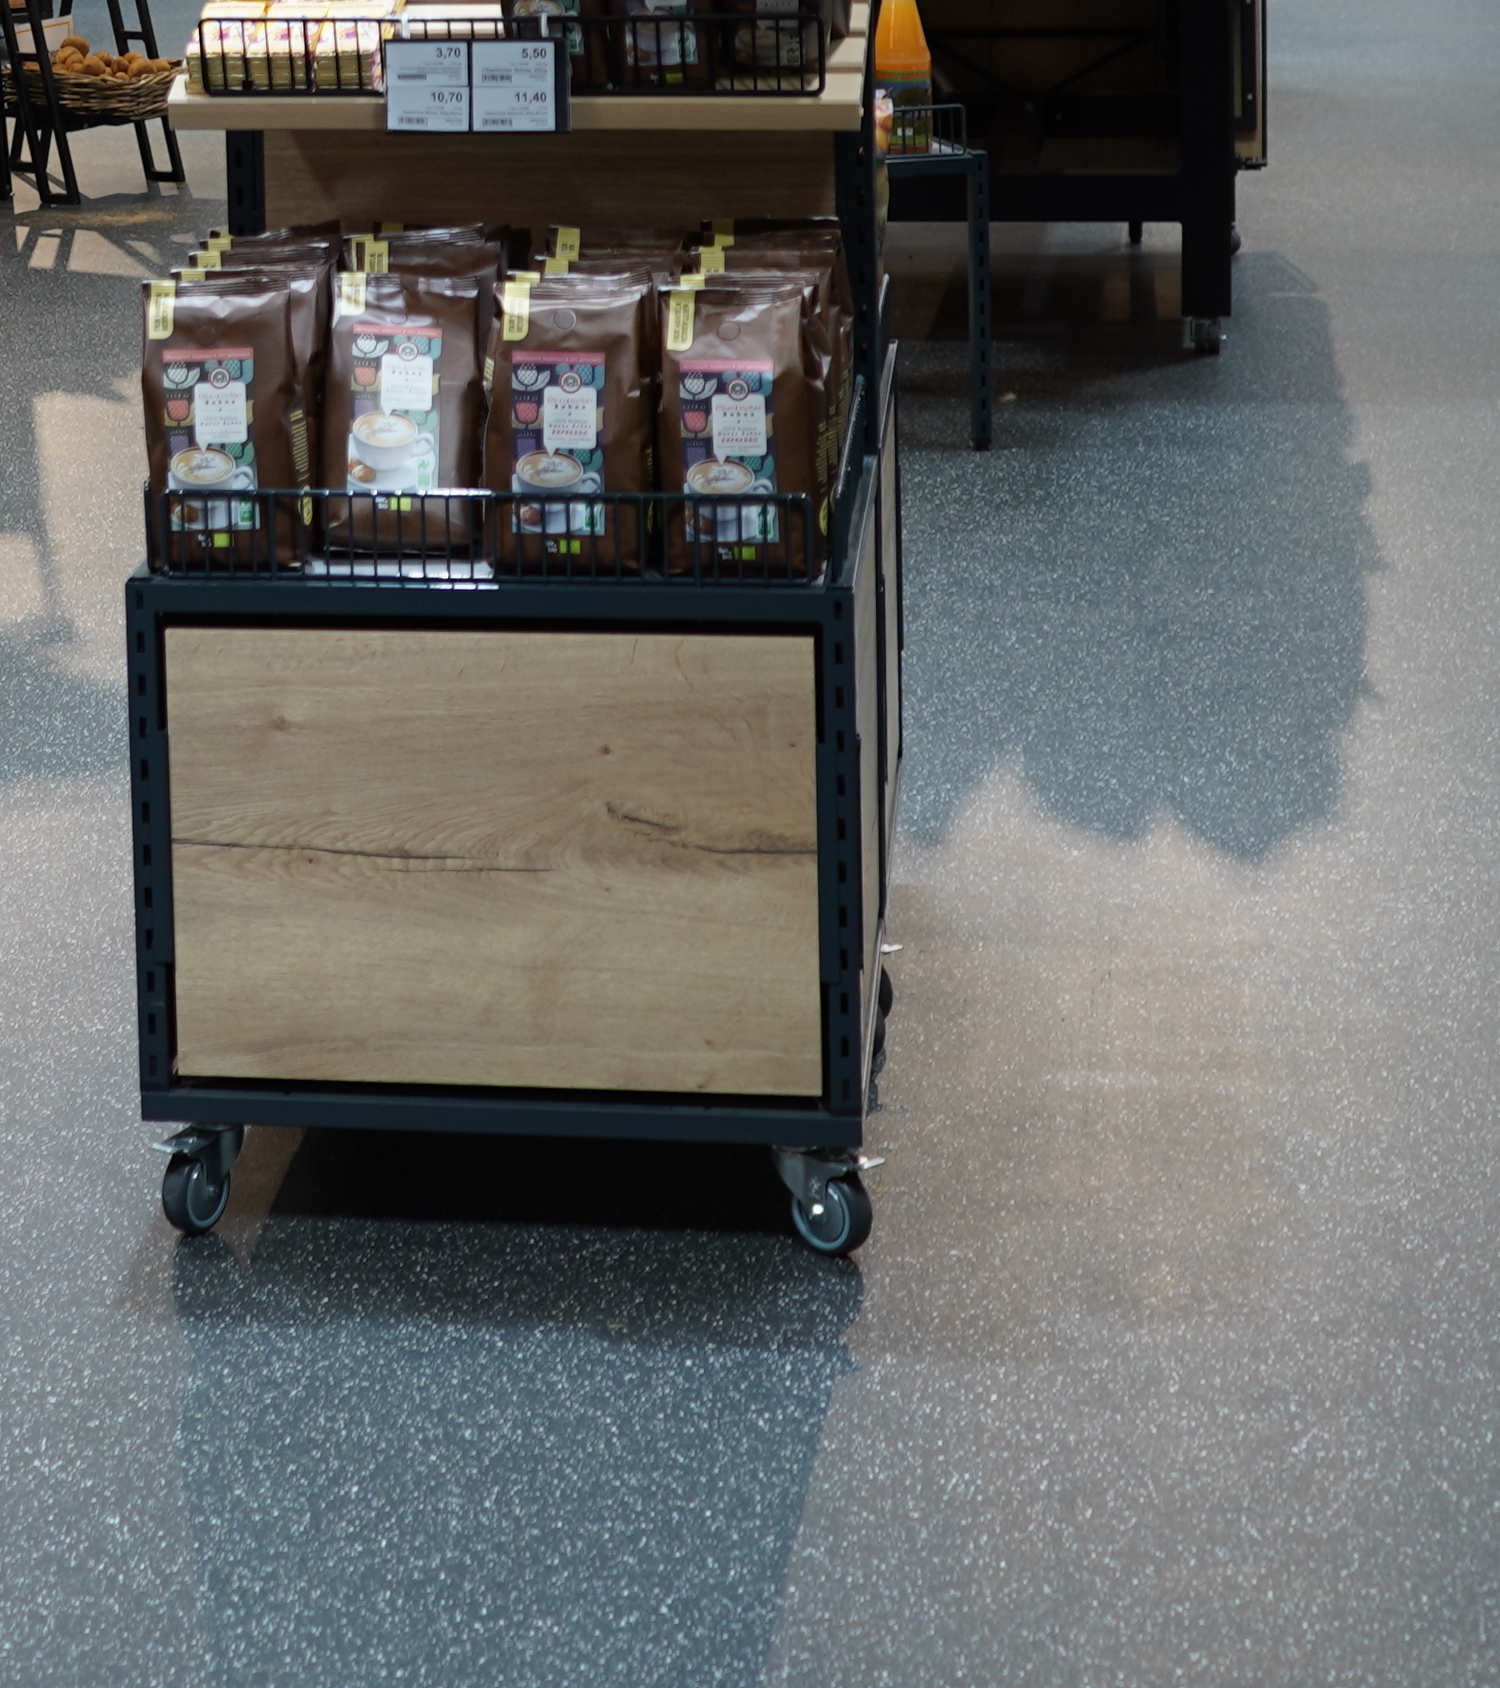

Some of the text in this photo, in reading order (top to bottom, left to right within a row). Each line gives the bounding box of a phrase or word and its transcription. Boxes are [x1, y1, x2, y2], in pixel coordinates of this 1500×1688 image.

[436, 47, 461, 59] 3,70
[522, 48, 547, 60] 5,50
[430, 92, 463, 104] 10,70
[515, 92, 547, 104] 11,40
